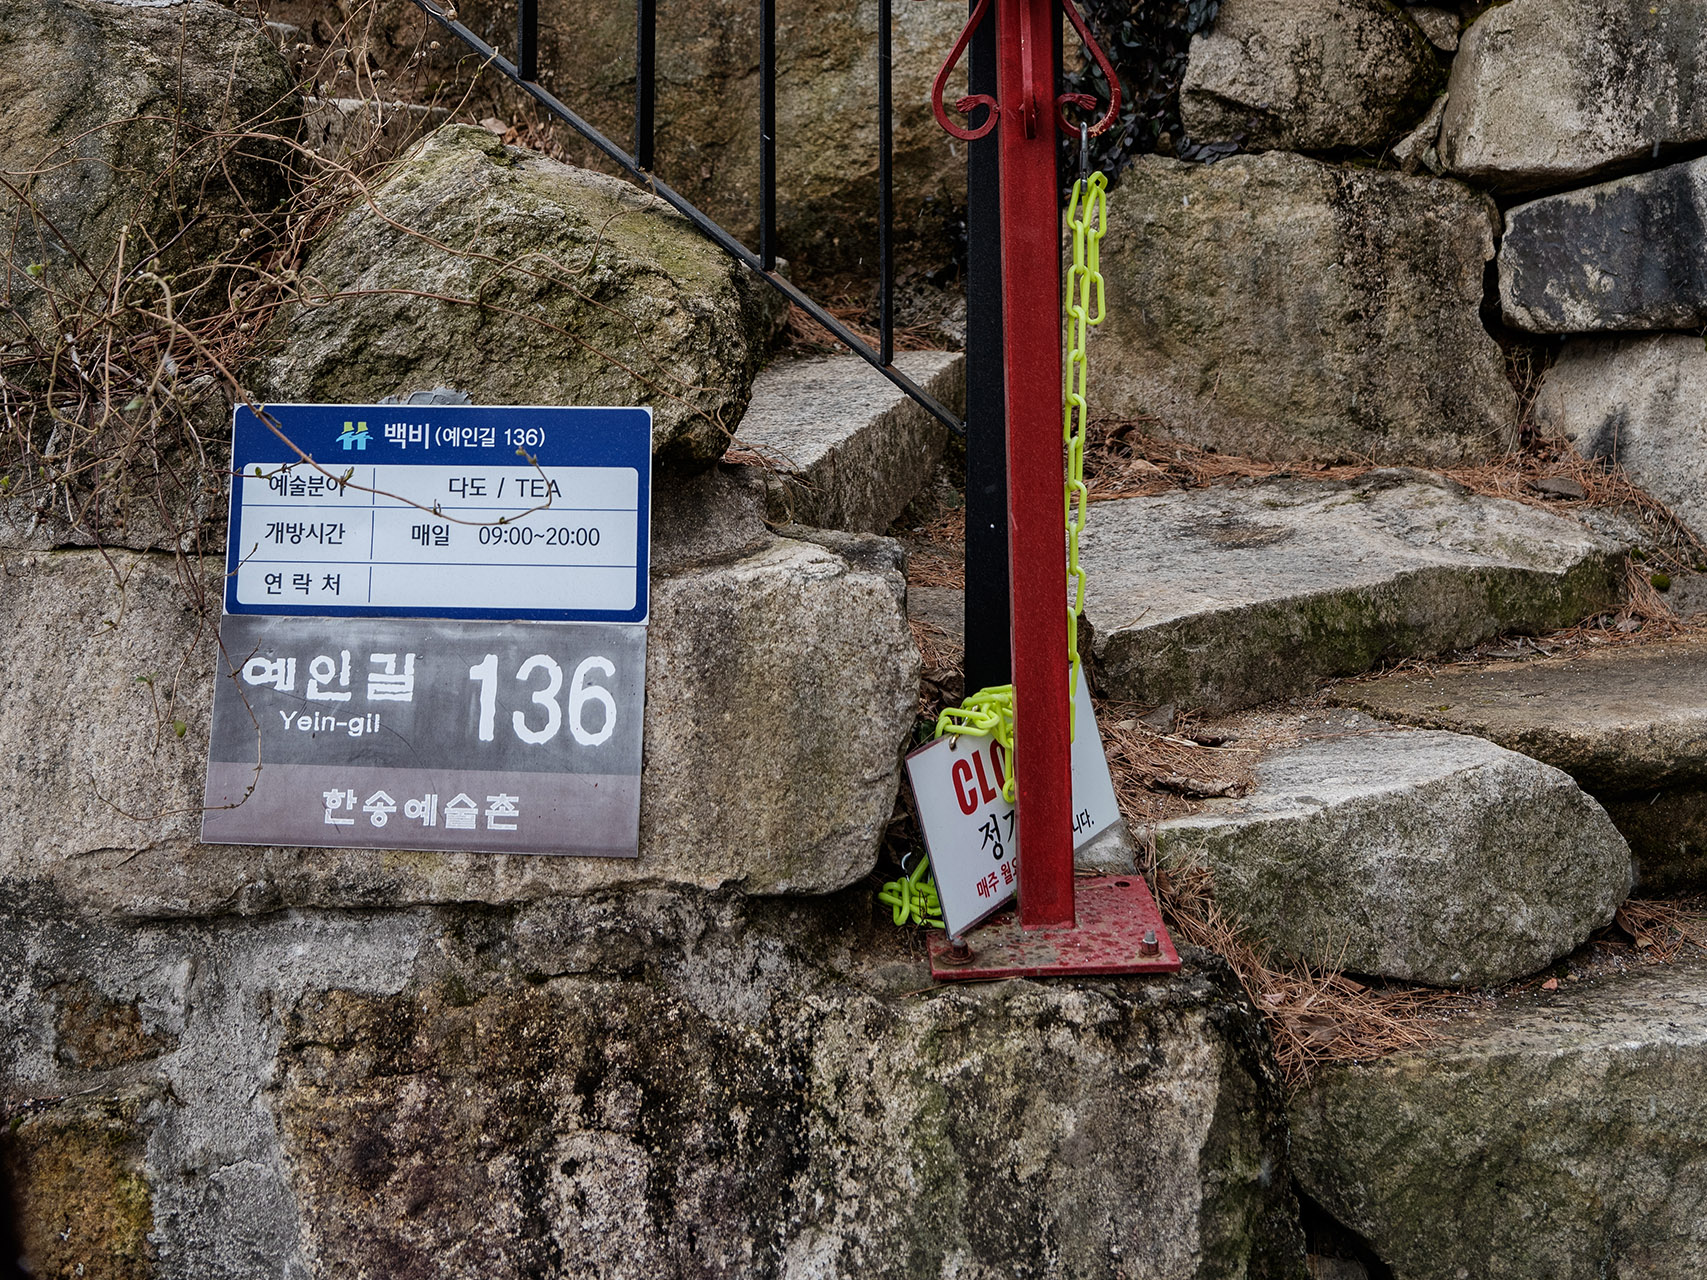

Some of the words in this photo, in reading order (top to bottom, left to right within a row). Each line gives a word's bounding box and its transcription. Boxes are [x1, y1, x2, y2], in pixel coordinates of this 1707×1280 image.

[384, 422, 430, 449] 백비
[435, 425, 496, 448] (예인길
[504, 427, 546, 448] 136)
[448, 477, 487, 499] 다도
[496, 477, 505, 499] /
[516, 479, 562, 499] TEA
[265, 522, 346, 546] 개방시간
[411, 524, 450, 547] 매일
[478, 527, 601, 547] 09:00~20:00
[242, 649, 416, 703] 예인길
[469, 653, 617, 747] 136
[279, 710, 381, 737] Yein-gil
[323, 788, 520, 831] 한송예술촌
[976, 871, 1000, 899] 매주
